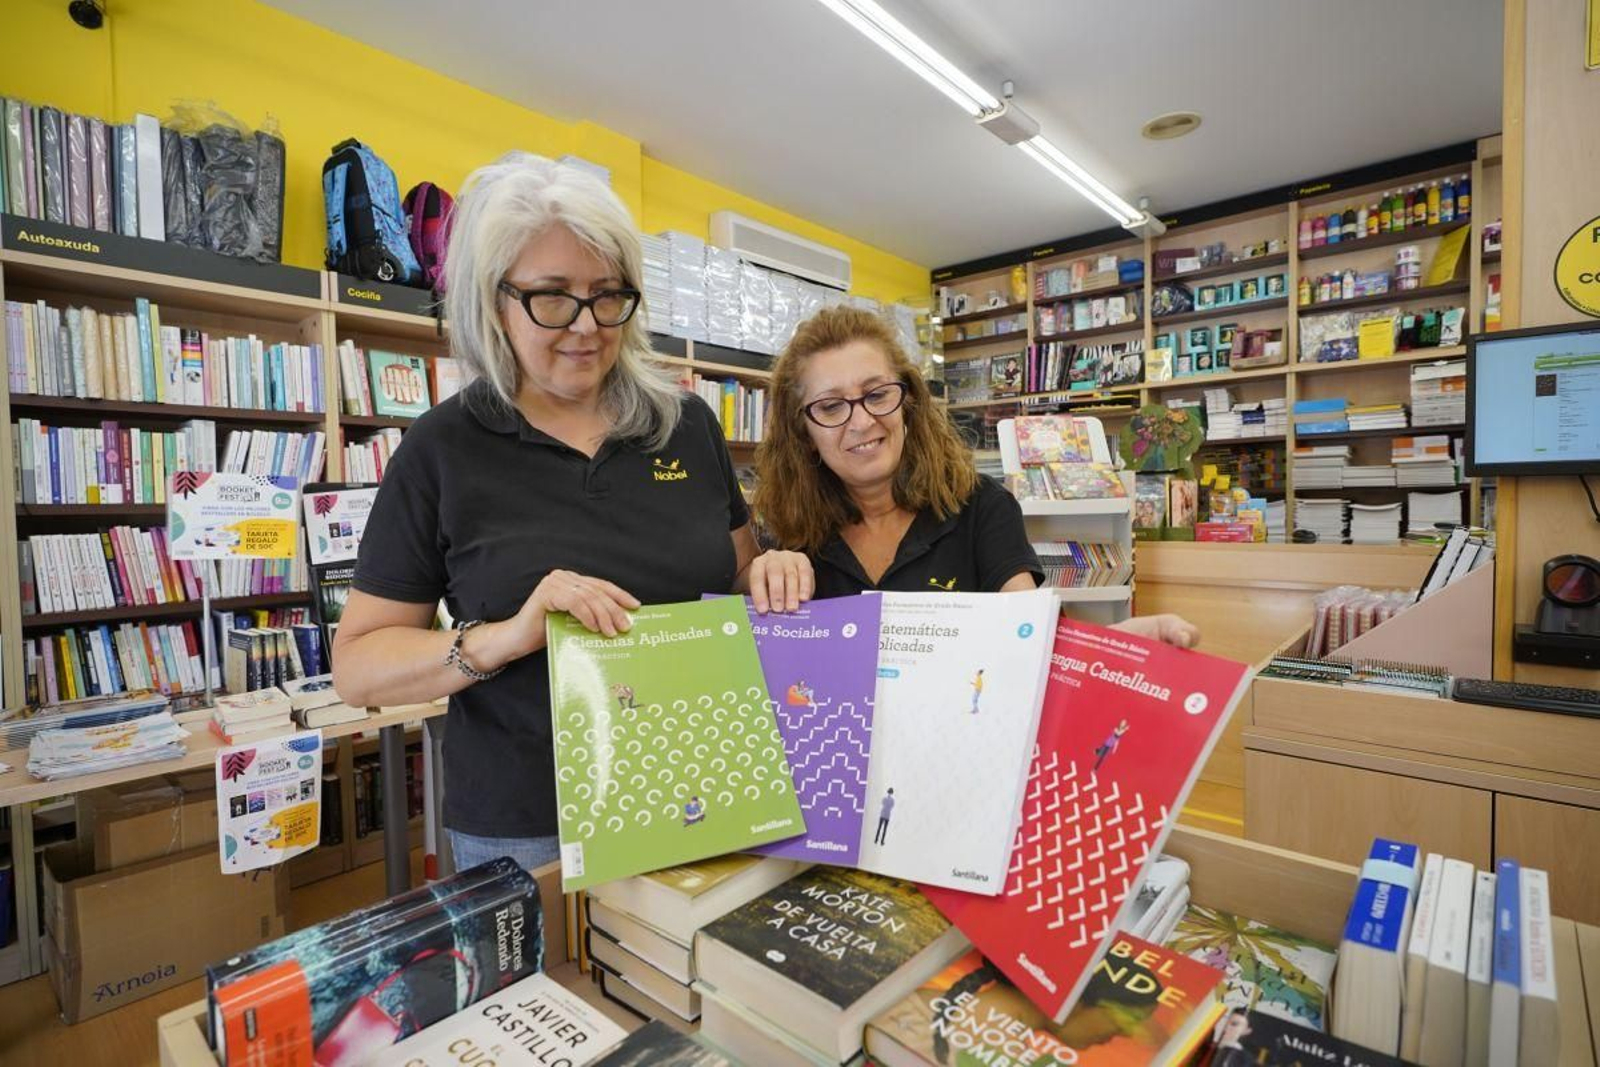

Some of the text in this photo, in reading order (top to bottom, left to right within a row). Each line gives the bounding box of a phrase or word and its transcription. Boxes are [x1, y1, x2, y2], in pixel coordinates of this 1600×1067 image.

[17, 230, 100, 253] Autoaxuda
[347, 287, 381, 301] Cociña
[653, 469, 688, 481] Nobel
[569, 626, 712, 649] Ciencias Aplicadas
[772, 625, 830, 638] Sociales
[879, 622, 959, 637] atemáticas
[1021, 625, 1029, 636] 2
[1050, 652, 1172, 701] engua Castellana
[750, 817, 793, 834] Santillana
[806, 839, 848, 852] Santillana
[951, 868, 989, 882] Santillana
[801, 885, 906, 934] MORTON
[841, 886, 894, 912] KATE
[495, 907, 512, 972] Redondo
[766, 917, 847, 960] A CASA
[773, 900, 877, 955] DE VUELTA
[512, 916, 525, 972] Dolores
[92, 964, 176, 1003] Arnoia
[517, 999, 589, 1048] JAVIER
[929, 998, 1040, 1066] CONOCE
[954, 991, 1079, 1065] EL VIENTO
